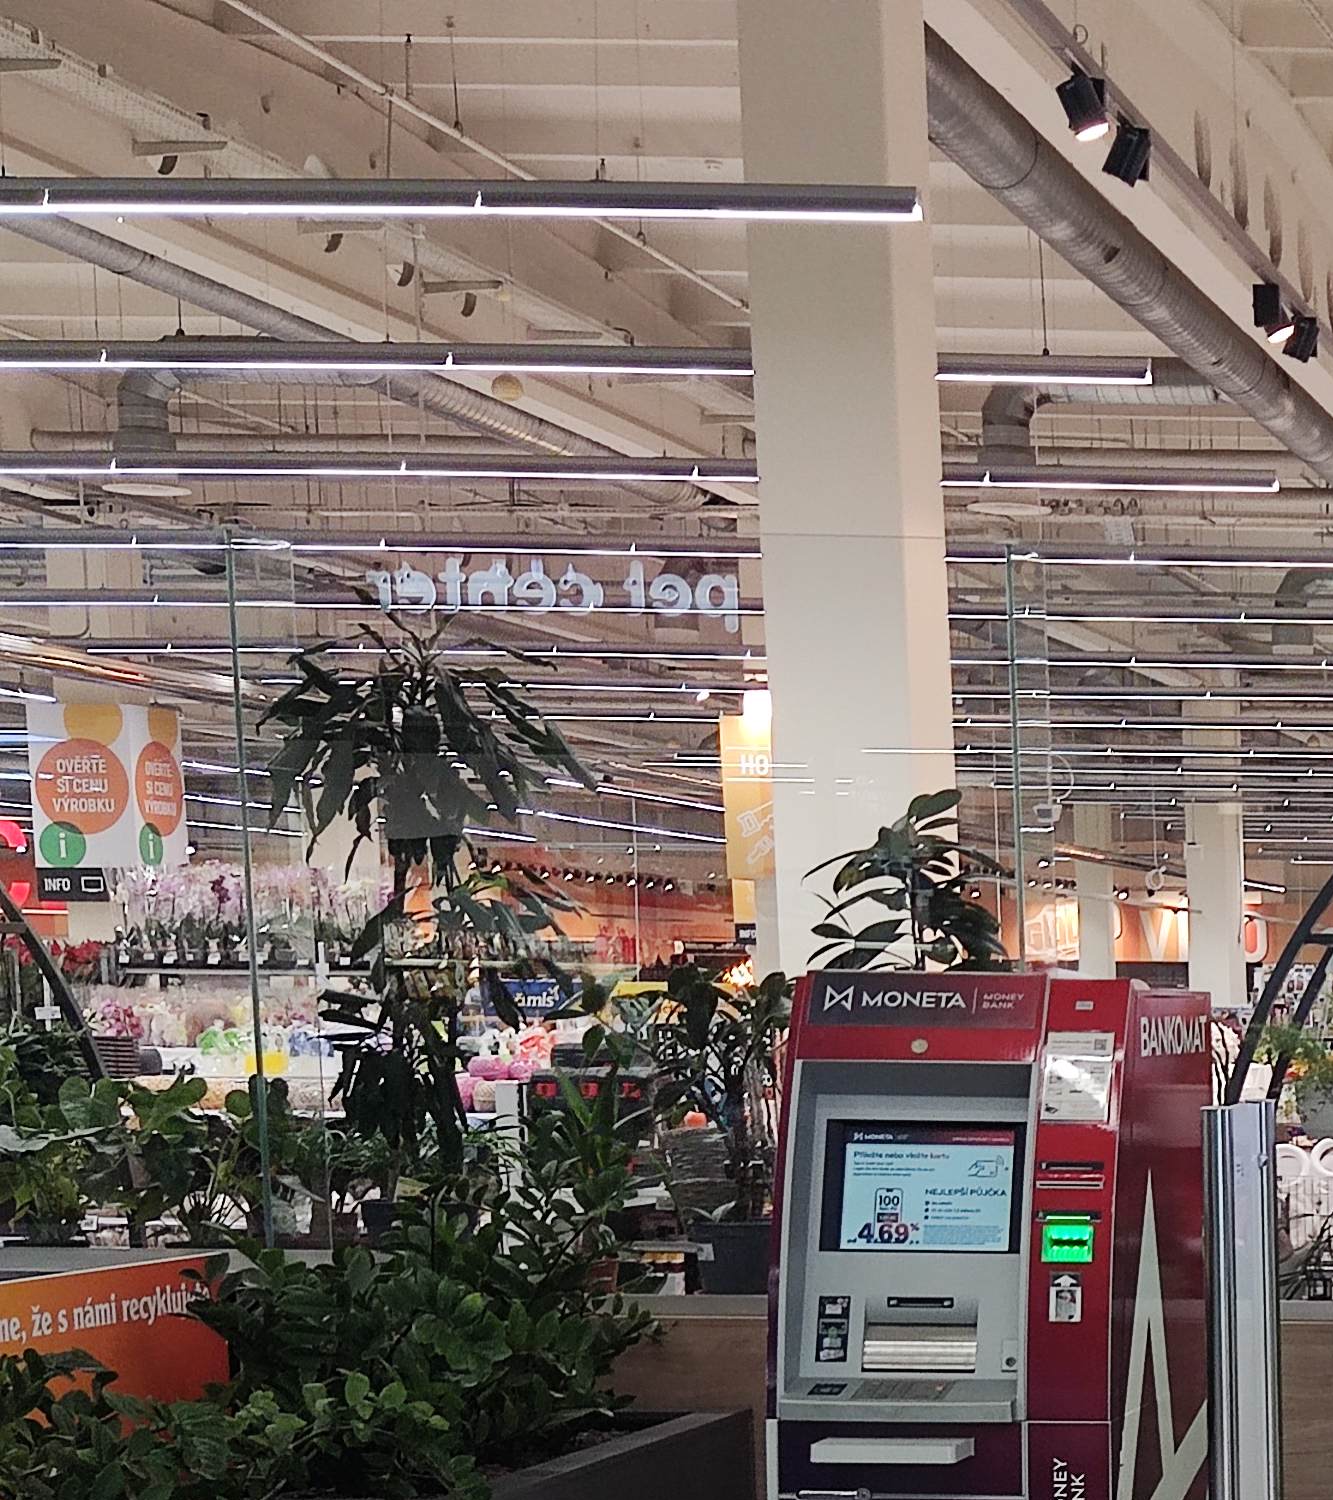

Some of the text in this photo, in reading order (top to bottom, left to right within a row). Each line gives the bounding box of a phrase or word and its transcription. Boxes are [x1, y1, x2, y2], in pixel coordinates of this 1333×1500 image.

[56, 755, 107, 774] OVĚŘTE
[56, 779, 108, 794] SI CENU
[53, 795, 115, 813] VÝROBKU
[44, 877, 71, 892] INFO
[861, 991, 967, 1010] MONETA
[983, 993, 1025, 1002] MONEY
[983, 1002, 1015, 1010] BANK
[1140, 1014, 1207, 1058] BANKOMAT
[925, 1187, 1007, 1197] NEJLEPŠÍ PŮJČKA
[878, 1195, 900, 1207] 100
[31, 1304, 53, 1337] že
[58, 1308, 68, 1333] s
[73, 1293, 117, 1331] námi
